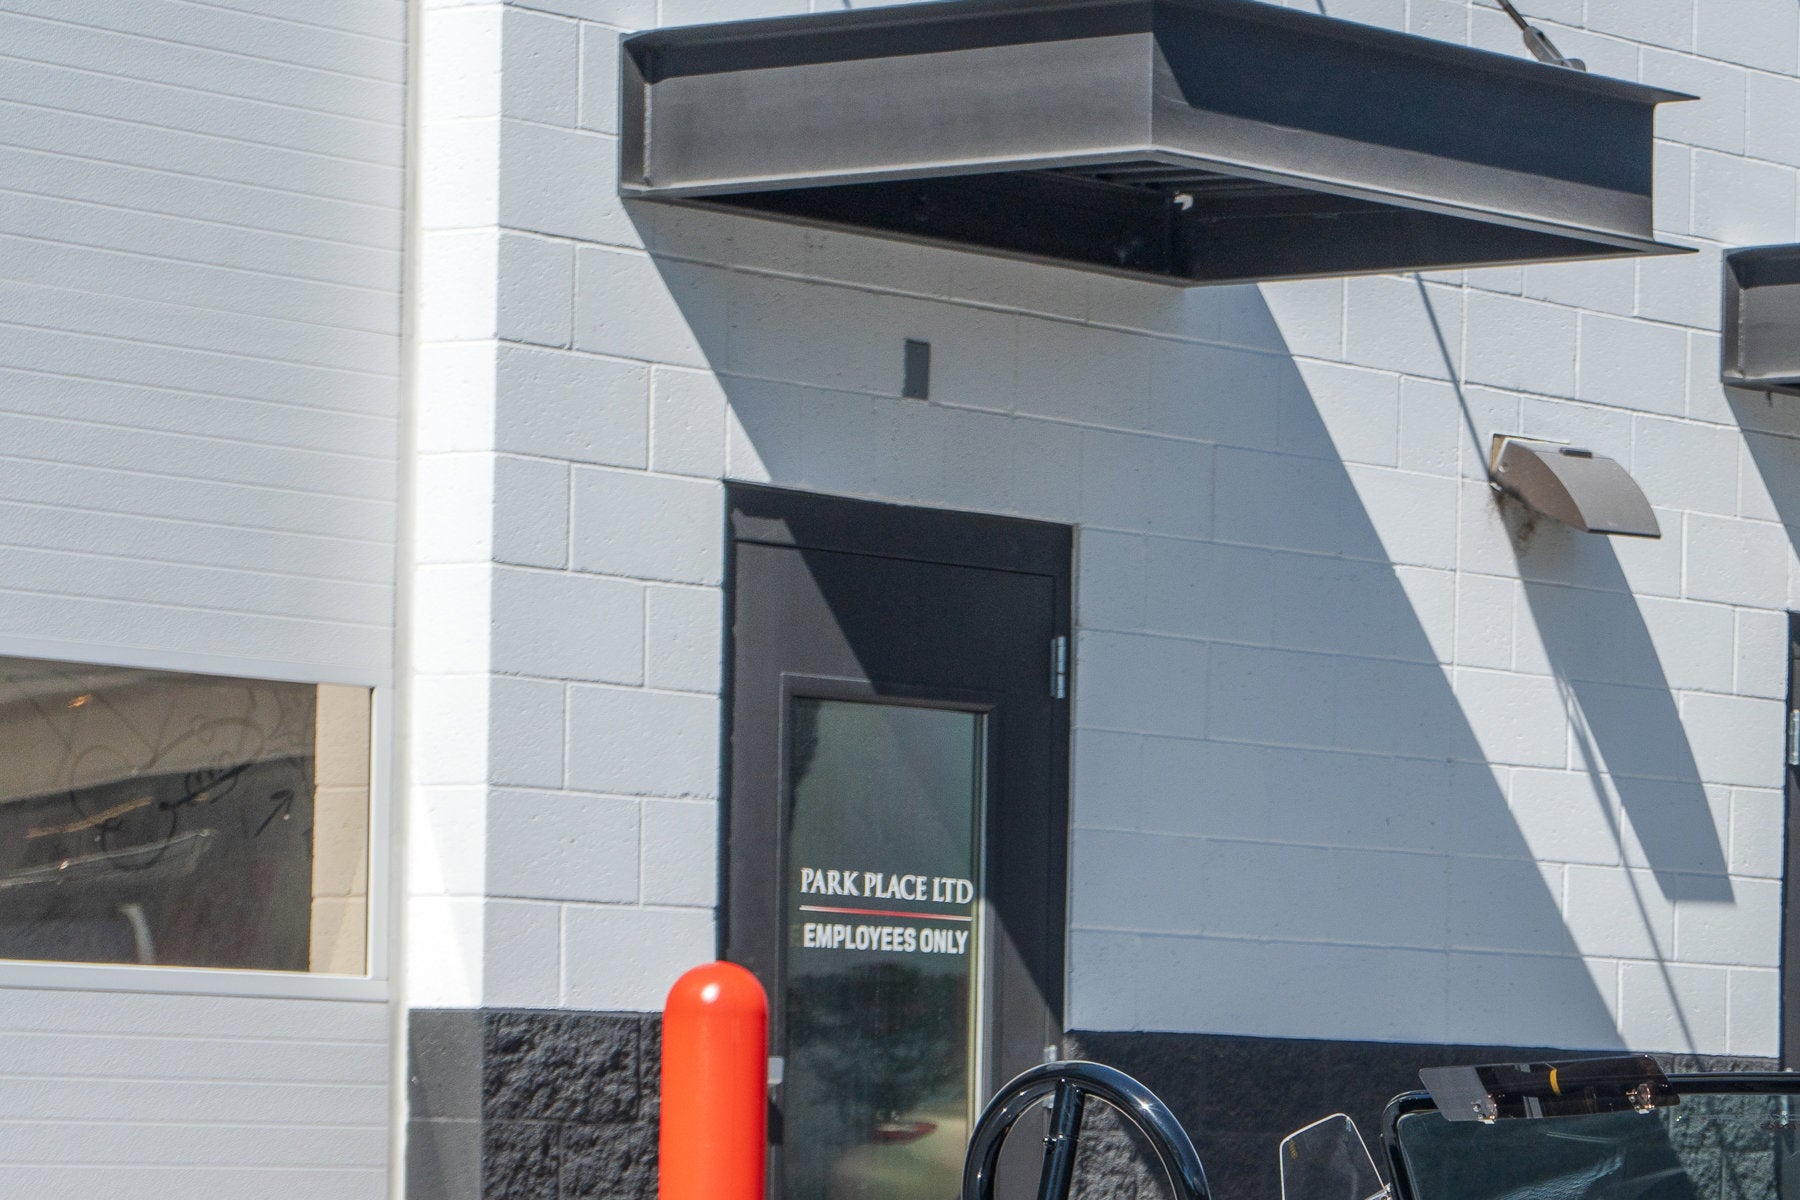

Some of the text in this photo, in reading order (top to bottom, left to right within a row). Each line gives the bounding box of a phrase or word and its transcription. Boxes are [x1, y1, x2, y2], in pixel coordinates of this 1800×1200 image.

[800, 867, 974, 904] PARK PLACE LTD
[803, 922, 969, 955] EMPLOYEES ONLY
